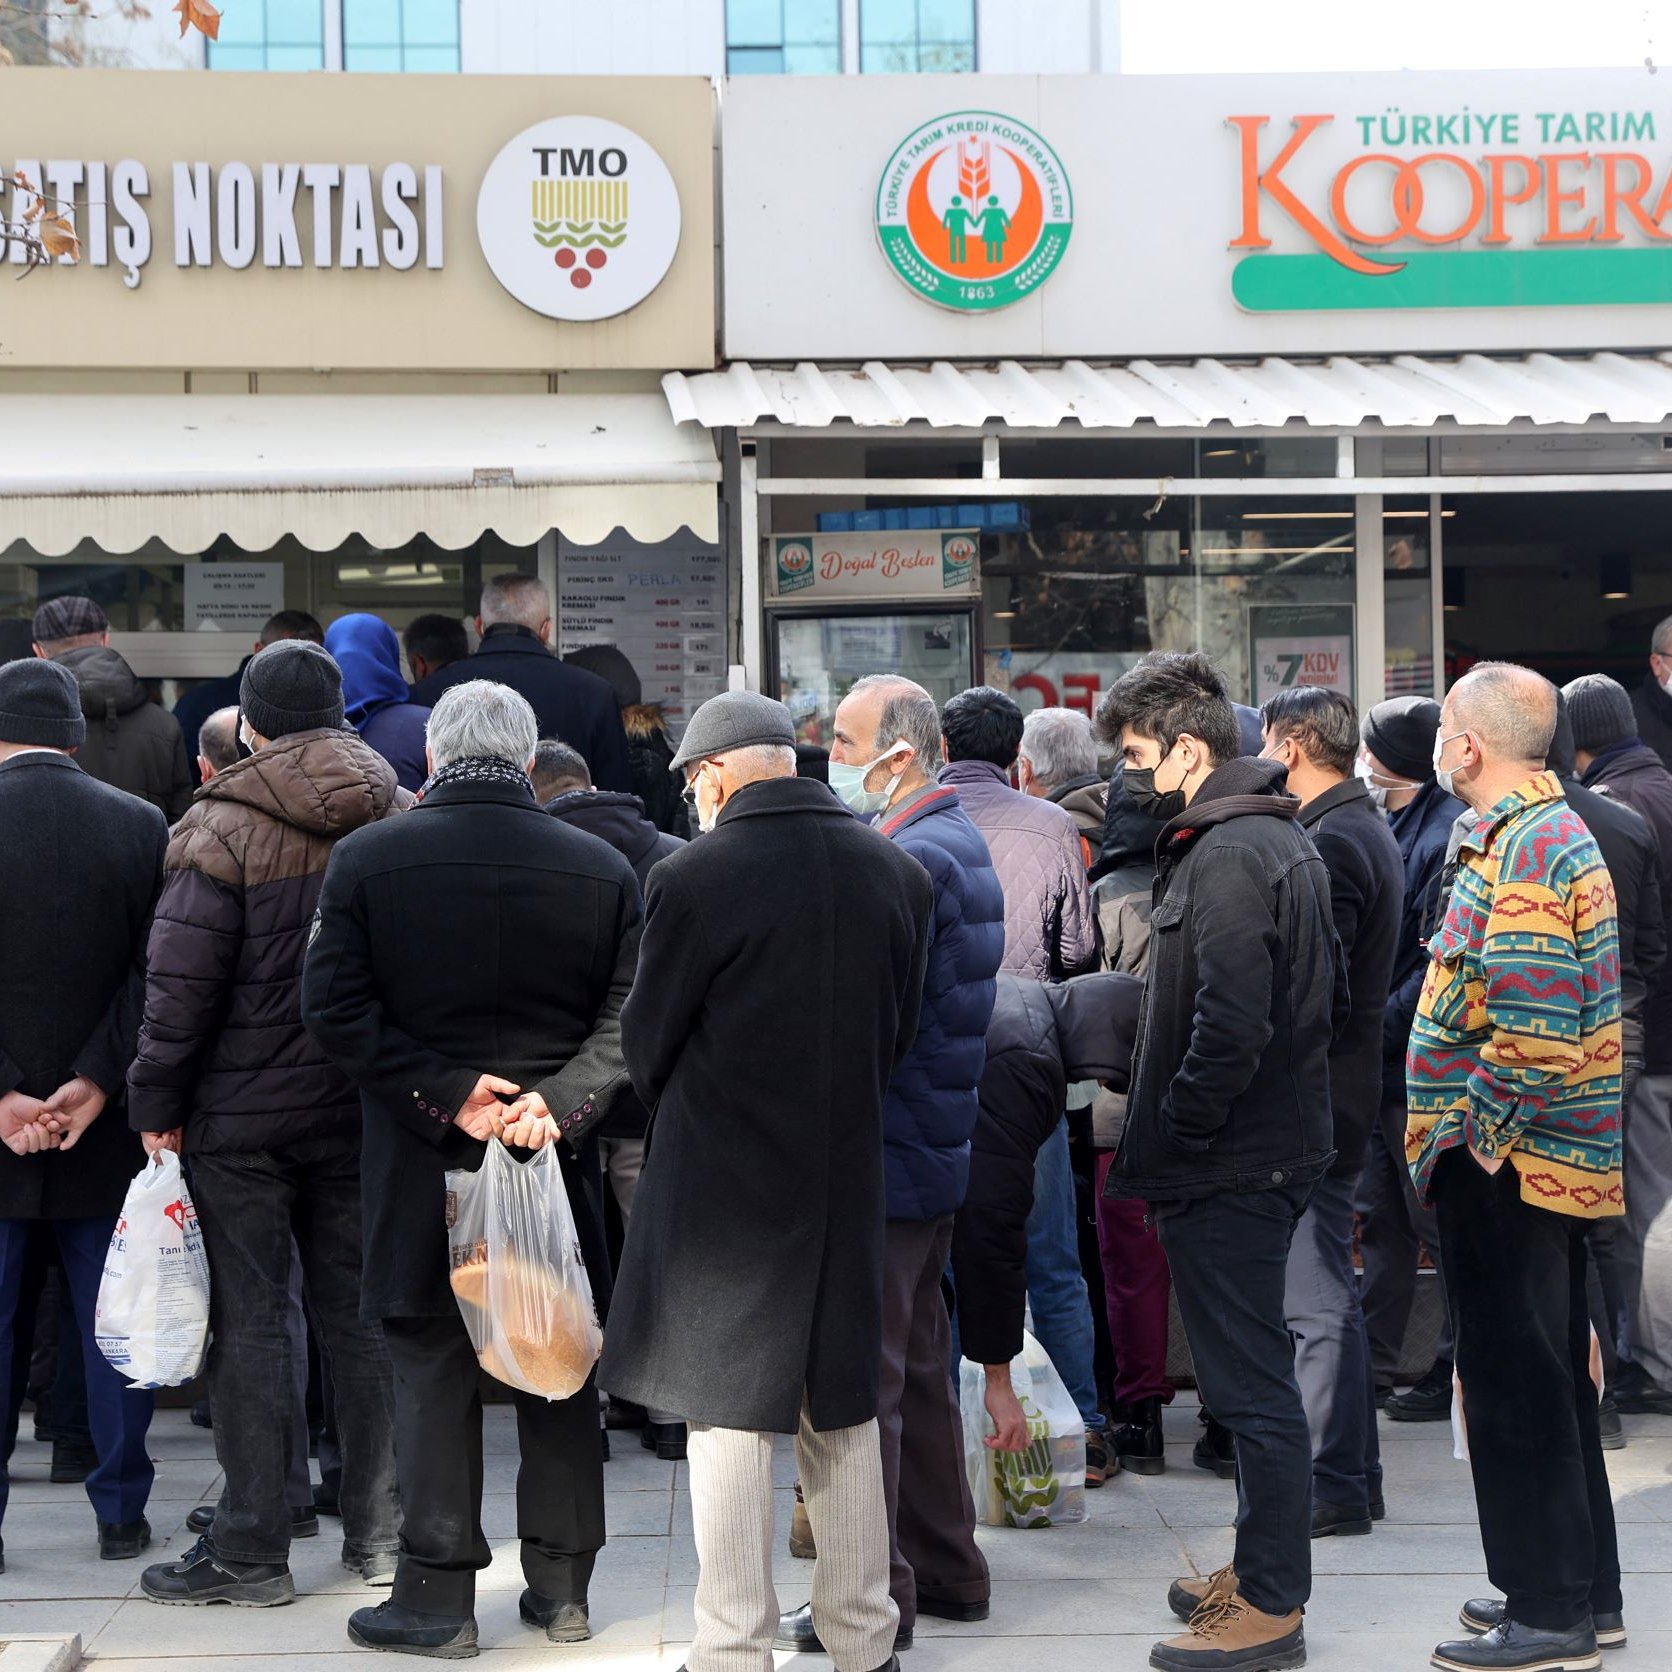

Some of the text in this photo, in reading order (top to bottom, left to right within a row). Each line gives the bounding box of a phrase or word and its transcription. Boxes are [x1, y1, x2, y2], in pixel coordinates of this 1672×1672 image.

[1356, 106, 1656, 146] TÜRKİYE TARIM
[532, 147, 628, 178] TMO
[886, 120, 1064, 218] TÜRKİYE TARIM KREDİ KOOPERATİFLERİ
[0, 158, 445, 289] ATIŞ NOKTASI
[959, 286, 996, 300] 1863
[820, 551, 877, 580] Doğal
[881, 547, 936, 578] Beslen
[1304, 652, 1340, 672] KDV
